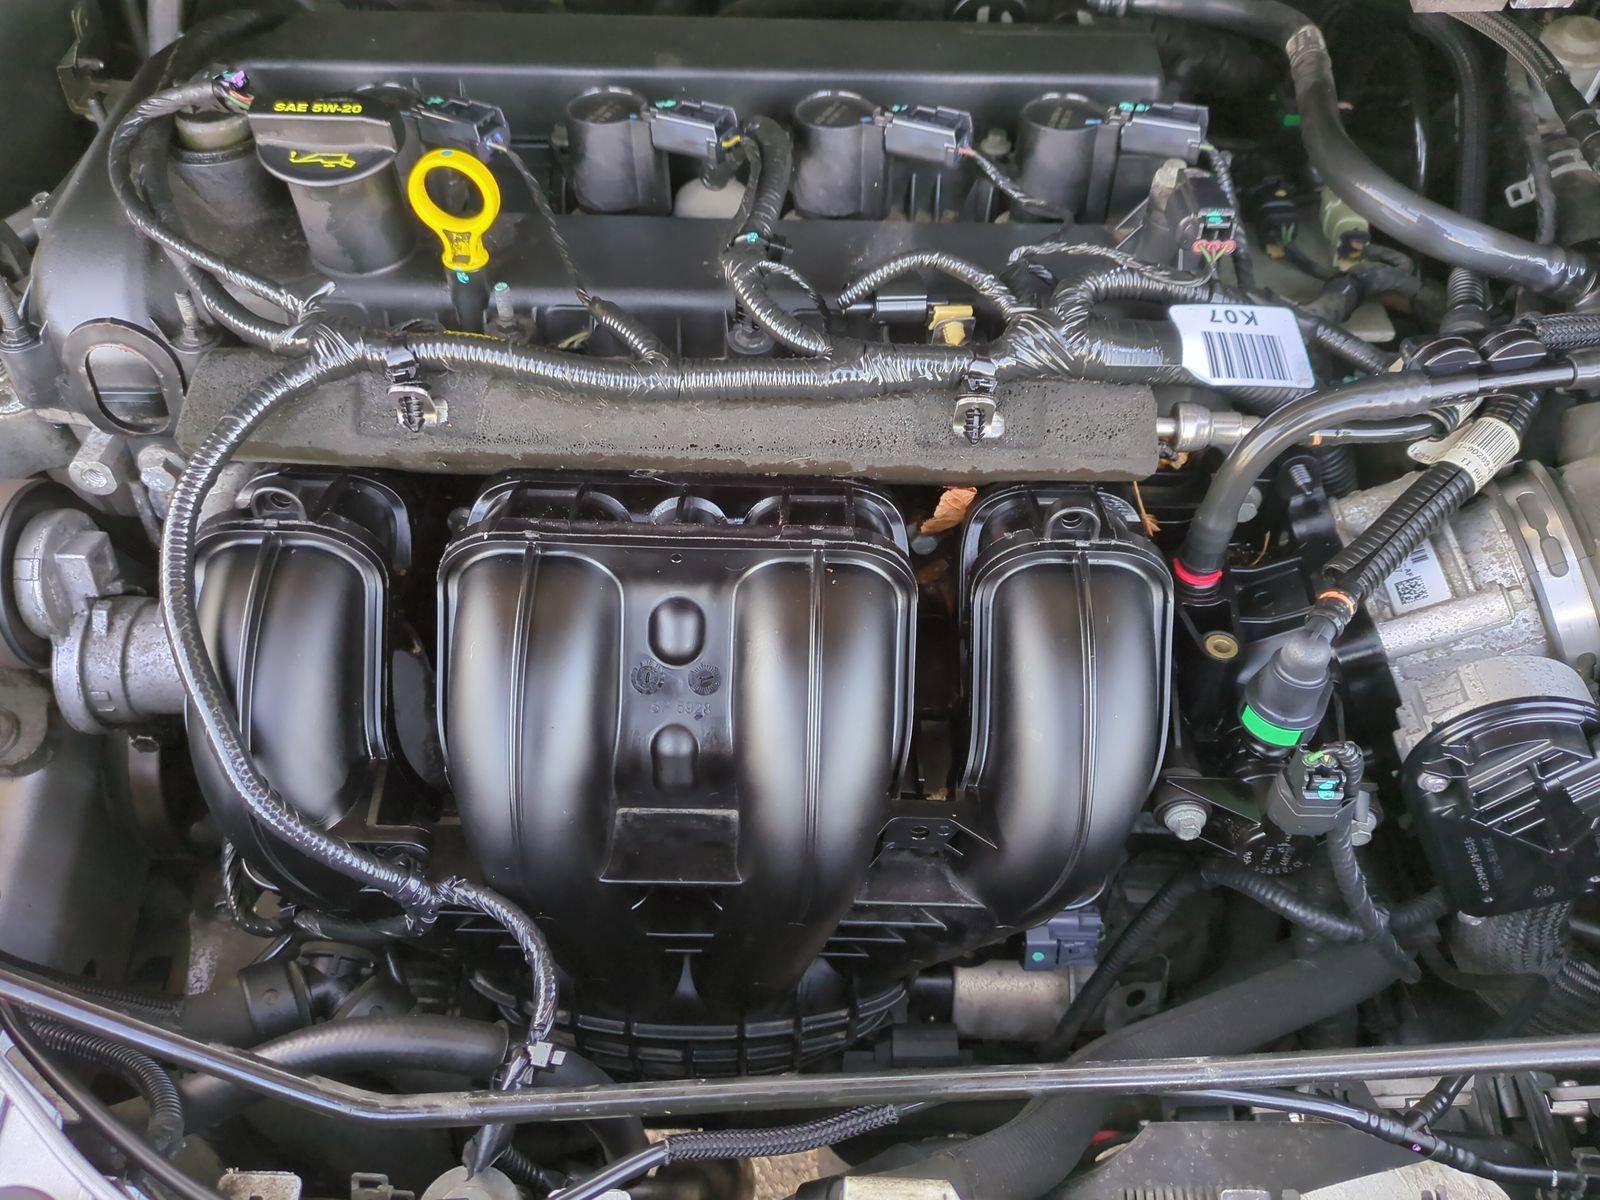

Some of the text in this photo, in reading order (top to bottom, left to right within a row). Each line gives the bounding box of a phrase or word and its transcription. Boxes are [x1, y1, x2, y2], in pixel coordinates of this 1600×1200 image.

[273, 102, 363, 114] SAE 5W-20
[1210, 309, 1258, 326] K07
